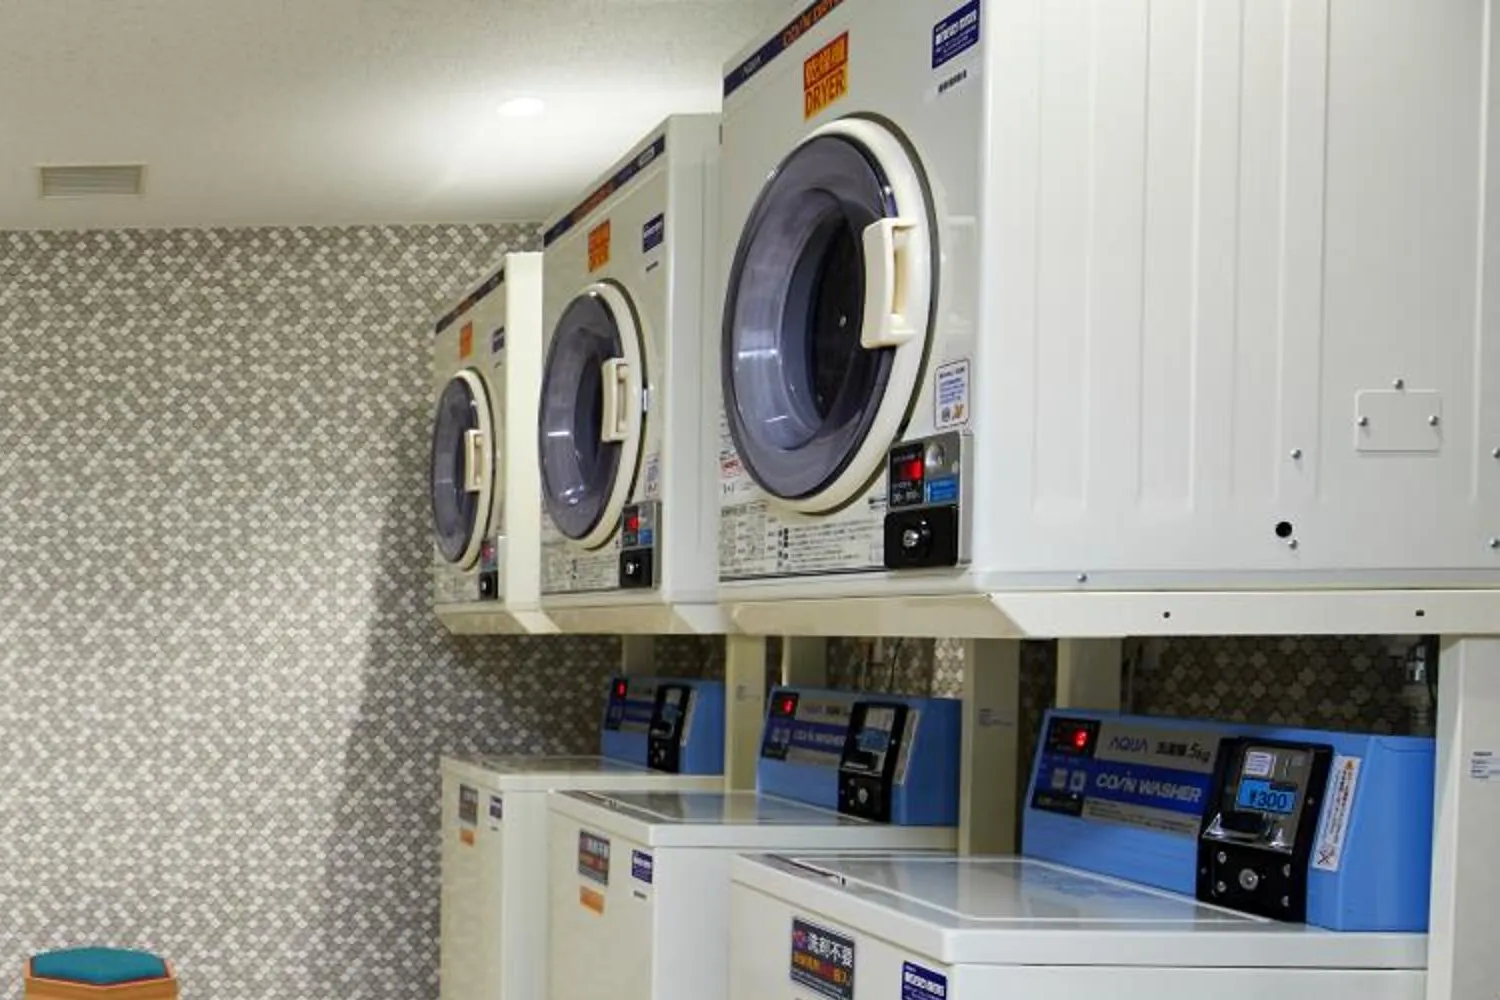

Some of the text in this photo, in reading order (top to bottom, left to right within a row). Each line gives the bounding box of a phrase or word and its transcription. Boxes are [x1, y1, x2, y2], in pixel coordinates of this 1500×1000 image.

[804, 67, 847, 119] DRYER
[1110, 735, 1149, 753] AQUA
[1138, 778, 1202, 804] WASHER
